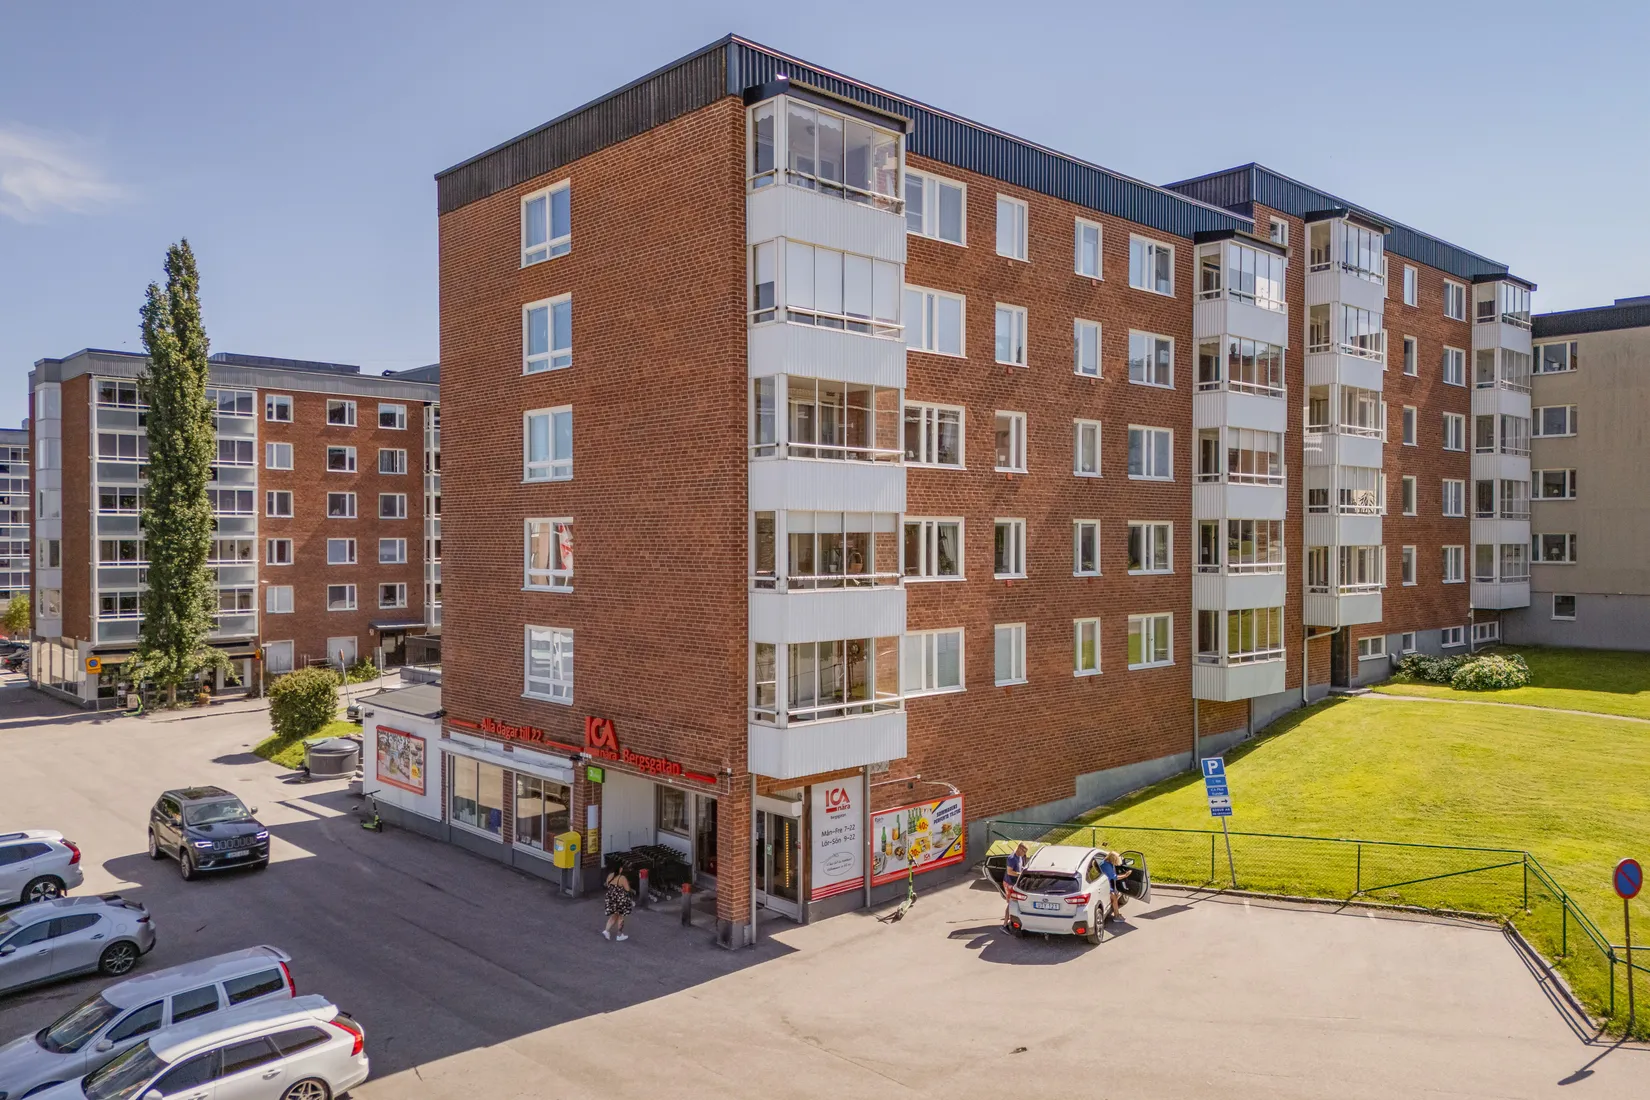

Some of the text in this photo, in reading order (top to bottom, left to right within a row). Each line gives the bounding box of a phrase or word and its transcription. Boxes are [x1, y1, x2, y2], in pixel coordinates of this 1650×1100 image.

[481, 718, 544, 741] Alla dagar till 22
[585, 716, 619, 751] ICA
[622, 748, 682, 775] Bergsgatan
[1207, 760, 1219, 775] P
[825, 787, 850, 807] ICA
[837, 804, 851, 812] nära
[821, 824, 855, 837] Mån-Fre 7-22
[821, 833, 855, 848] Lör-Sön 9-22
